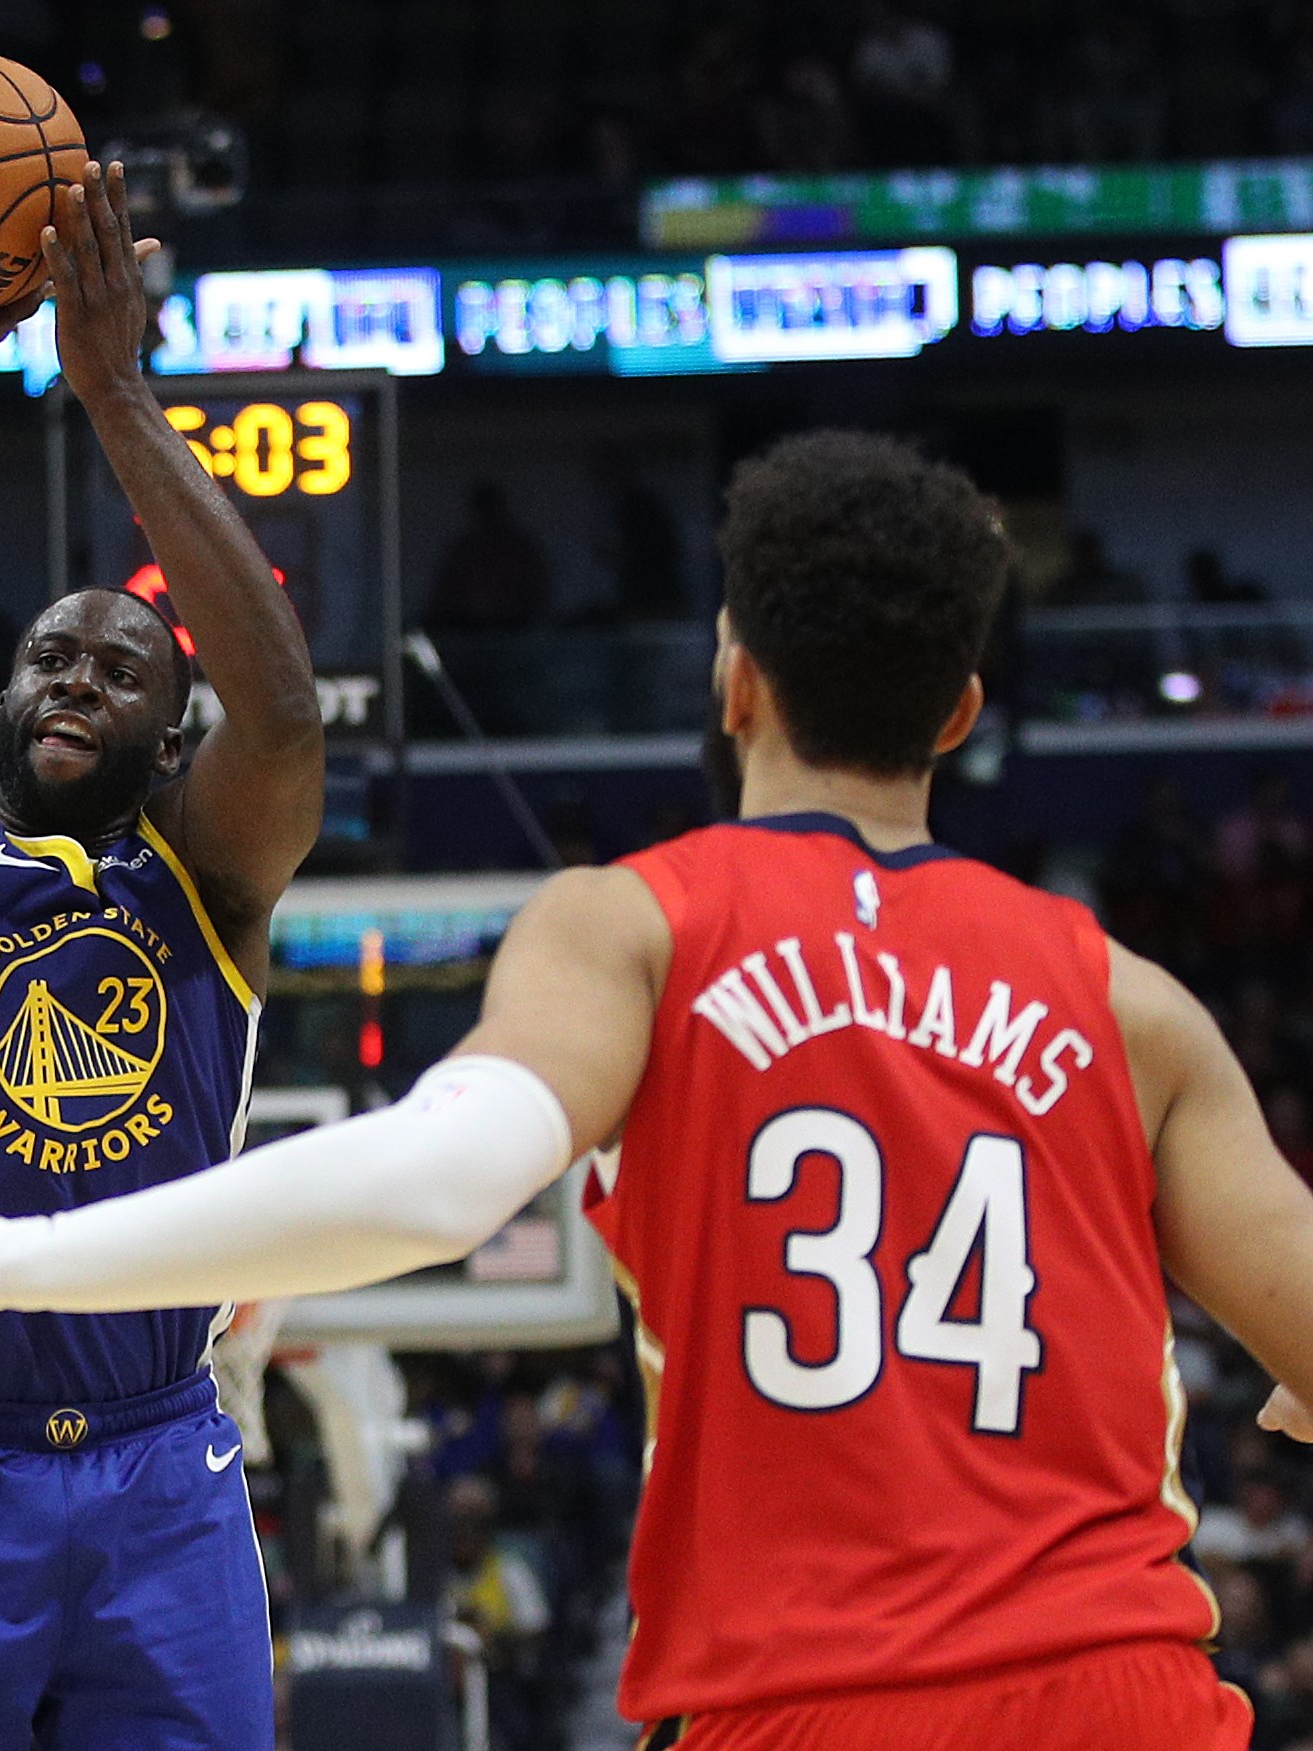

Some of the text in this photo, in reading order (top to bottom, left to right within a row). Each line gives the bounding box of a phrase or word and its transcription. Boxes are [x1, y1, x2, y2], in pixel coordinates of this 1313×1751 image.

[455, 273, 711, 354] PEOPLES
[973, 259, 1226, 334] PEOPLES
[103, 905, 173, 965] STATE
[95, 975, 154, 1034] 23
[691, 931, 1094, 1117] WILLIAMS
[740, 1104, 1045, 1438] 34
[48, 1417, 87, 1444] W
